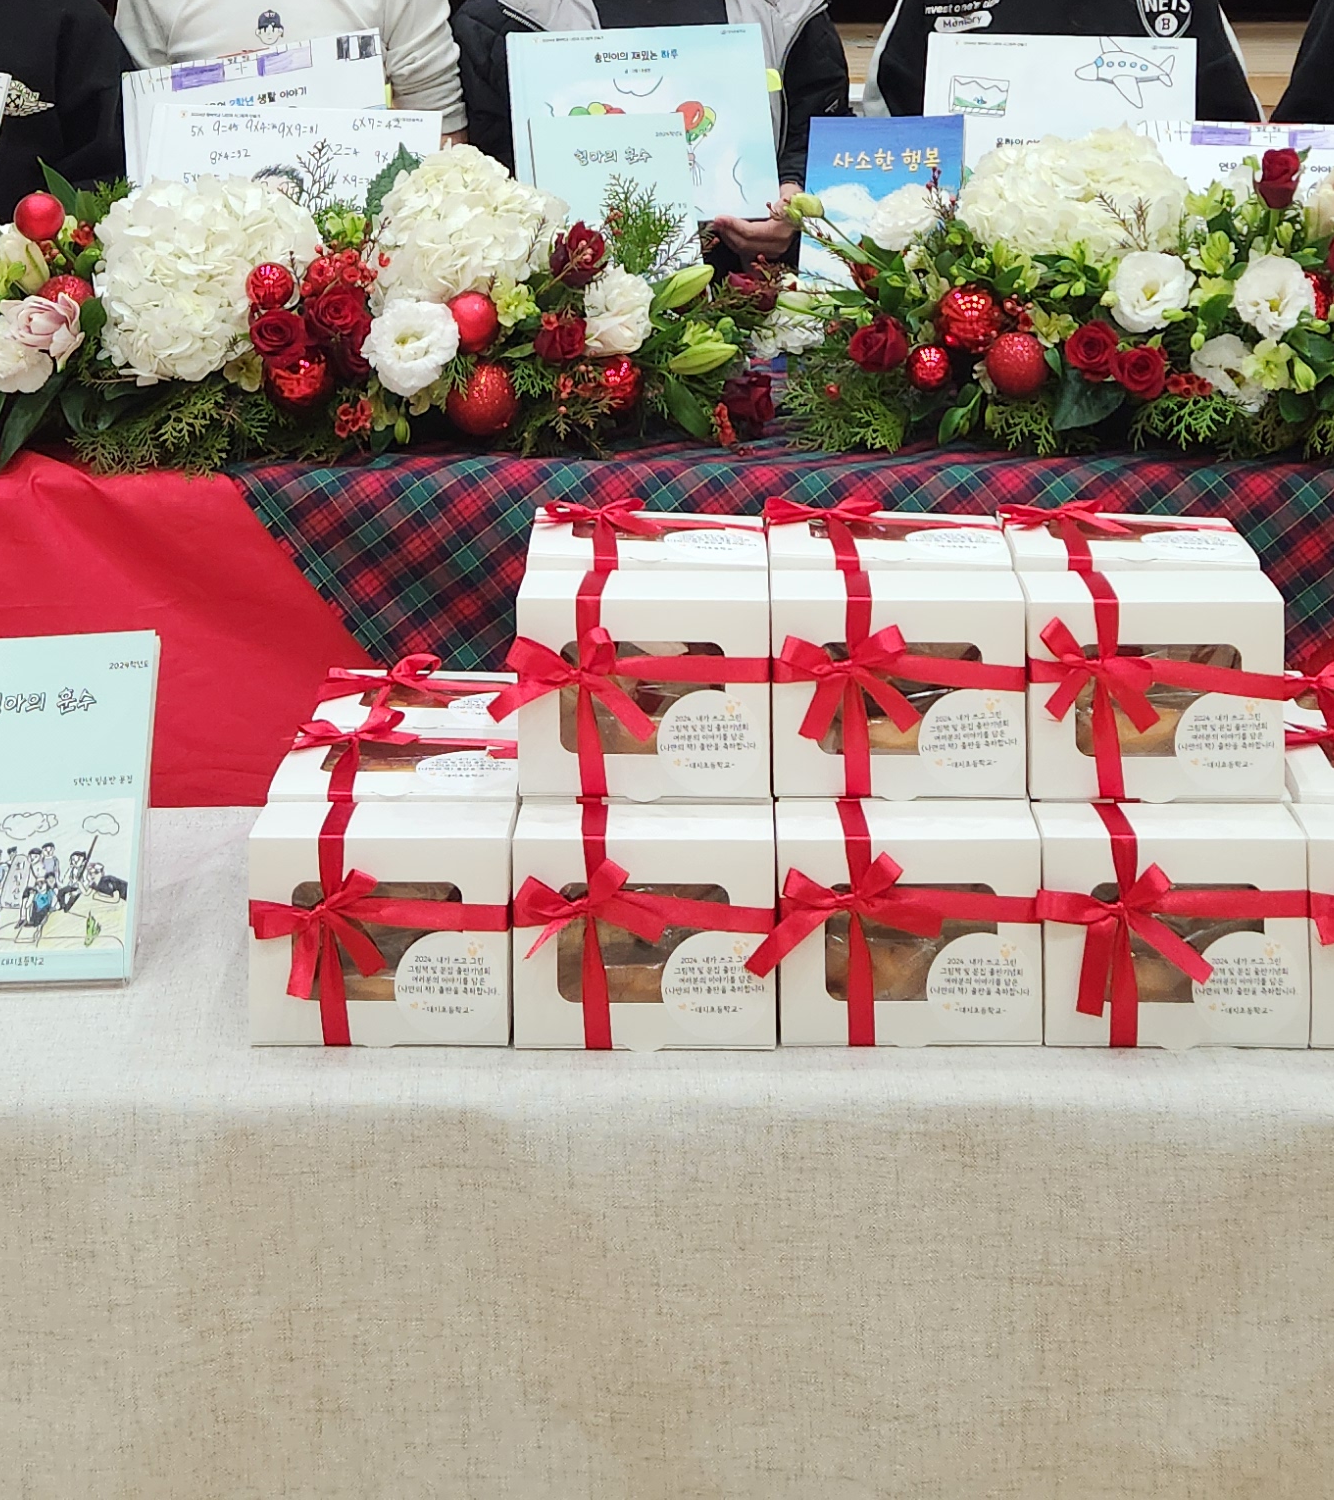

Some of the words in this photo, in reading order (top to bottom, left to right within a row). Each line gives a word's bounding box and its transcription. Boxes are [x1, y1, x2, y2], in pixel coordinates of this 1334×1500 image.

[661, 49, 678, 59] 하루
[280, 86, 306, 98] 이야기
[574, 149, 618, 166] 형아의
[833, 148, 895, 171] 사소한
[901, 147, 940, 172] 행복
[56, 687, 97, 715] 훈수
